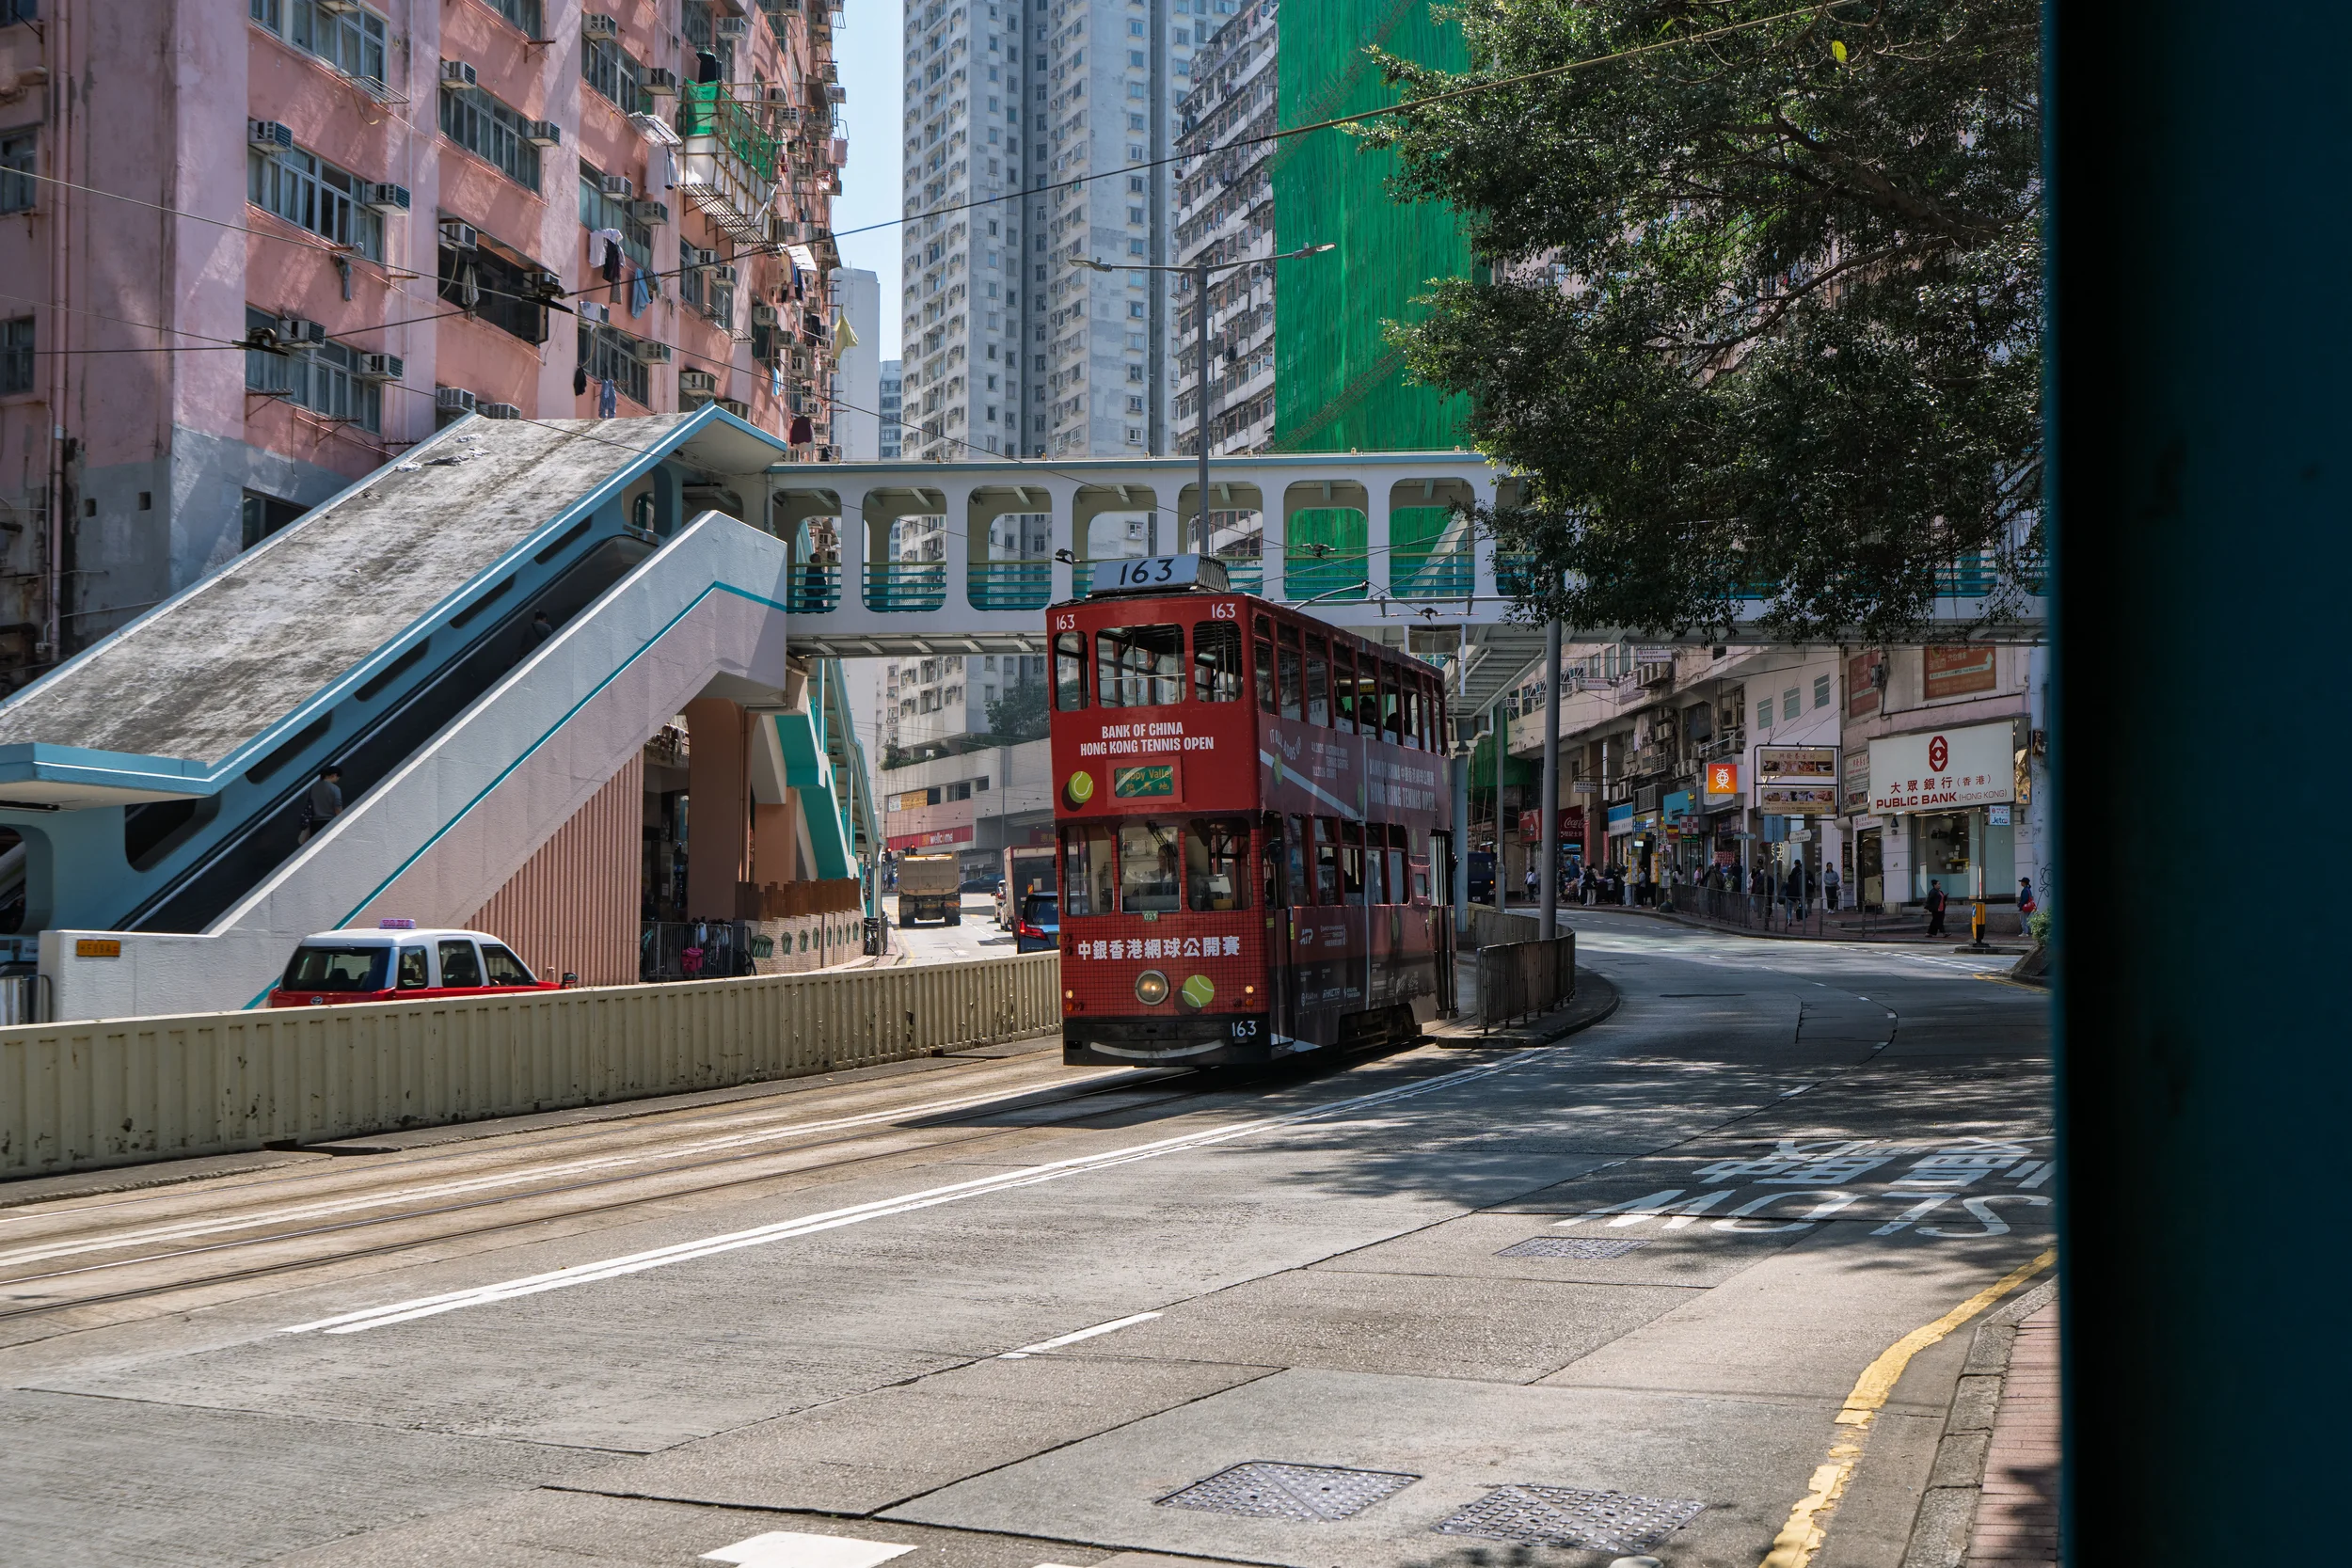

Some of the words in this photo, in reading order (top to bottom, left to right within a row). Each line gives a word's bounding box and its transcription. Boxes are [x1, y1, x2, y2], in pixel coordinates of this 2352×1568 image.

[1120, 558, 1174, 585] 163
[1212, 603, 1236, 619] 163
[1057, 614, 1075, 630] 163
[1102, 724, 1130, 738] BANK
[1133, 723, 1146, 736] OF
[1149, 721, 1184, 736] CHINA
[1080, 741, 1107, 756] HONG
[1110, 739, 1138, 754] KONG
[1141, 737, 1181, 752] TENNIS
[1184, 736, 1215, 751] OPEN
[1149, 768, 1173, 780] Valley
[1369, 758, 1382, 776] BANK
[1388, 763, 1400, 780] CHINA
[1370, 782, 1387, 804] HONG
[1387, 784, 1401, 807] KONG
[1402, 786, 1422, 811] TENNIS
[1422, 790, 1436, 812] OPEN
[1876, 796, 1918, 810] PUBLIC
[1921, 792, 1958, 805] BANK
[1959, 791, 1982, 802] (HONG
[1983, 788, 2008, 799] KONG)
[382, 919, 410, 927] TAXI
[1144, 912, 1157, 921] 021
[1298, 927, 1313, 944] ATP
[1077, 935, 1240, 960] 中銀香港網球公開賽
[1232, 1020, 1257, 1037] 163
[1691, 1136, 2056, 1188] 慢駛
[1551, 1189, 2055, 1238] SLOW
